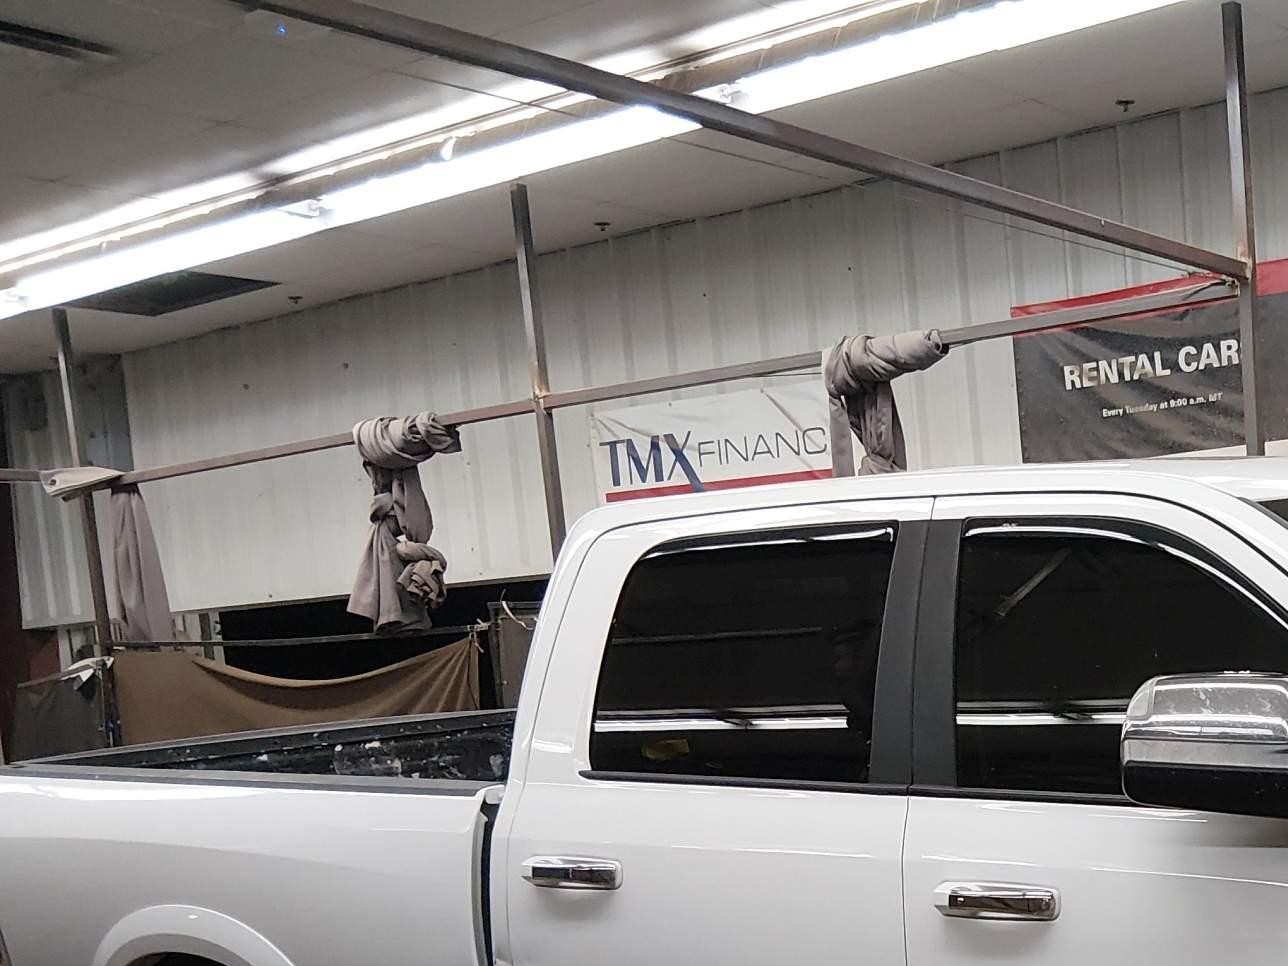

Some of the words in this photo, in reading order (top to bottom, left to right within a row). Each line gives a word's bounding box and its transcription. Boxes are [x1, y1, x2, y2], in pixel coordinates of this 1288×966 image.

[1063, 350, 1171, 391] RENTAL
[1178, 339, 1240, 374] CAR
[1102, 407, 1123, 418] Every
[1125, 403, 1159, 415] Tuesday
[1159, 401, 1169, 410] at
[598, 430, 706, 493] TMX
